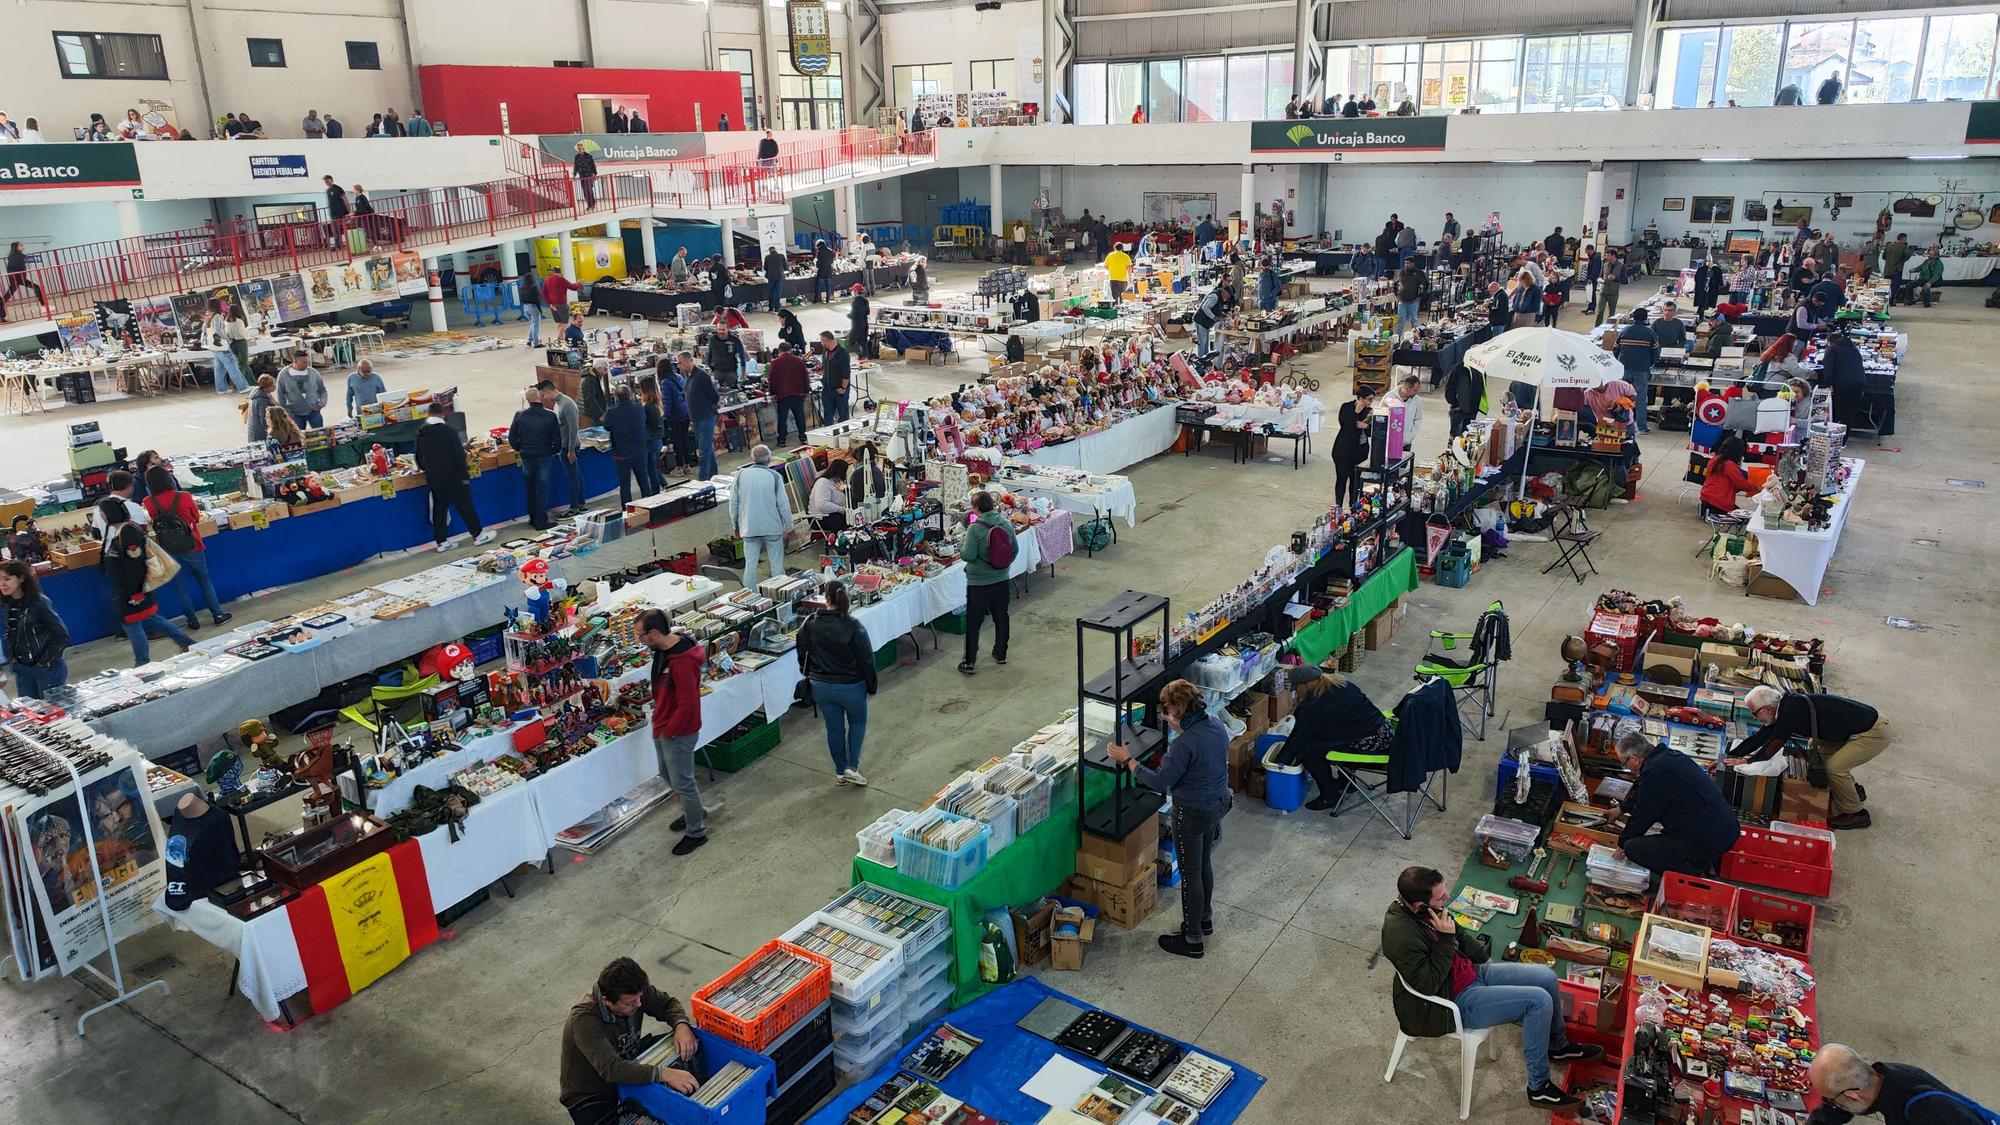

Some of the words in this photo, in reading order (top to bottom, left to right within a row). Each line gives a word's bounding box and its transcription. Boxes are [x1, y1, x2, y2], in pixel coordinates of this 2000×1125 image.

[1317, 131, 1364, 148] Unicaja
[1366, 132, 1406, 144] Banco
[603, 145, 645, 160] Unicaja
[645, 146, 678, 157] Banco
[14, 162, 80, 179] Banco
[253, 168, 276, 176] RECINTO
[1506, 350, 1516, 358] El
[1511, 359, 1530, 368] Negra
[1551, 377, 1569, 385] Cerveza
[1569, 376, 1591, 385] Especial
[168, 881, 186, 893] E.T.
